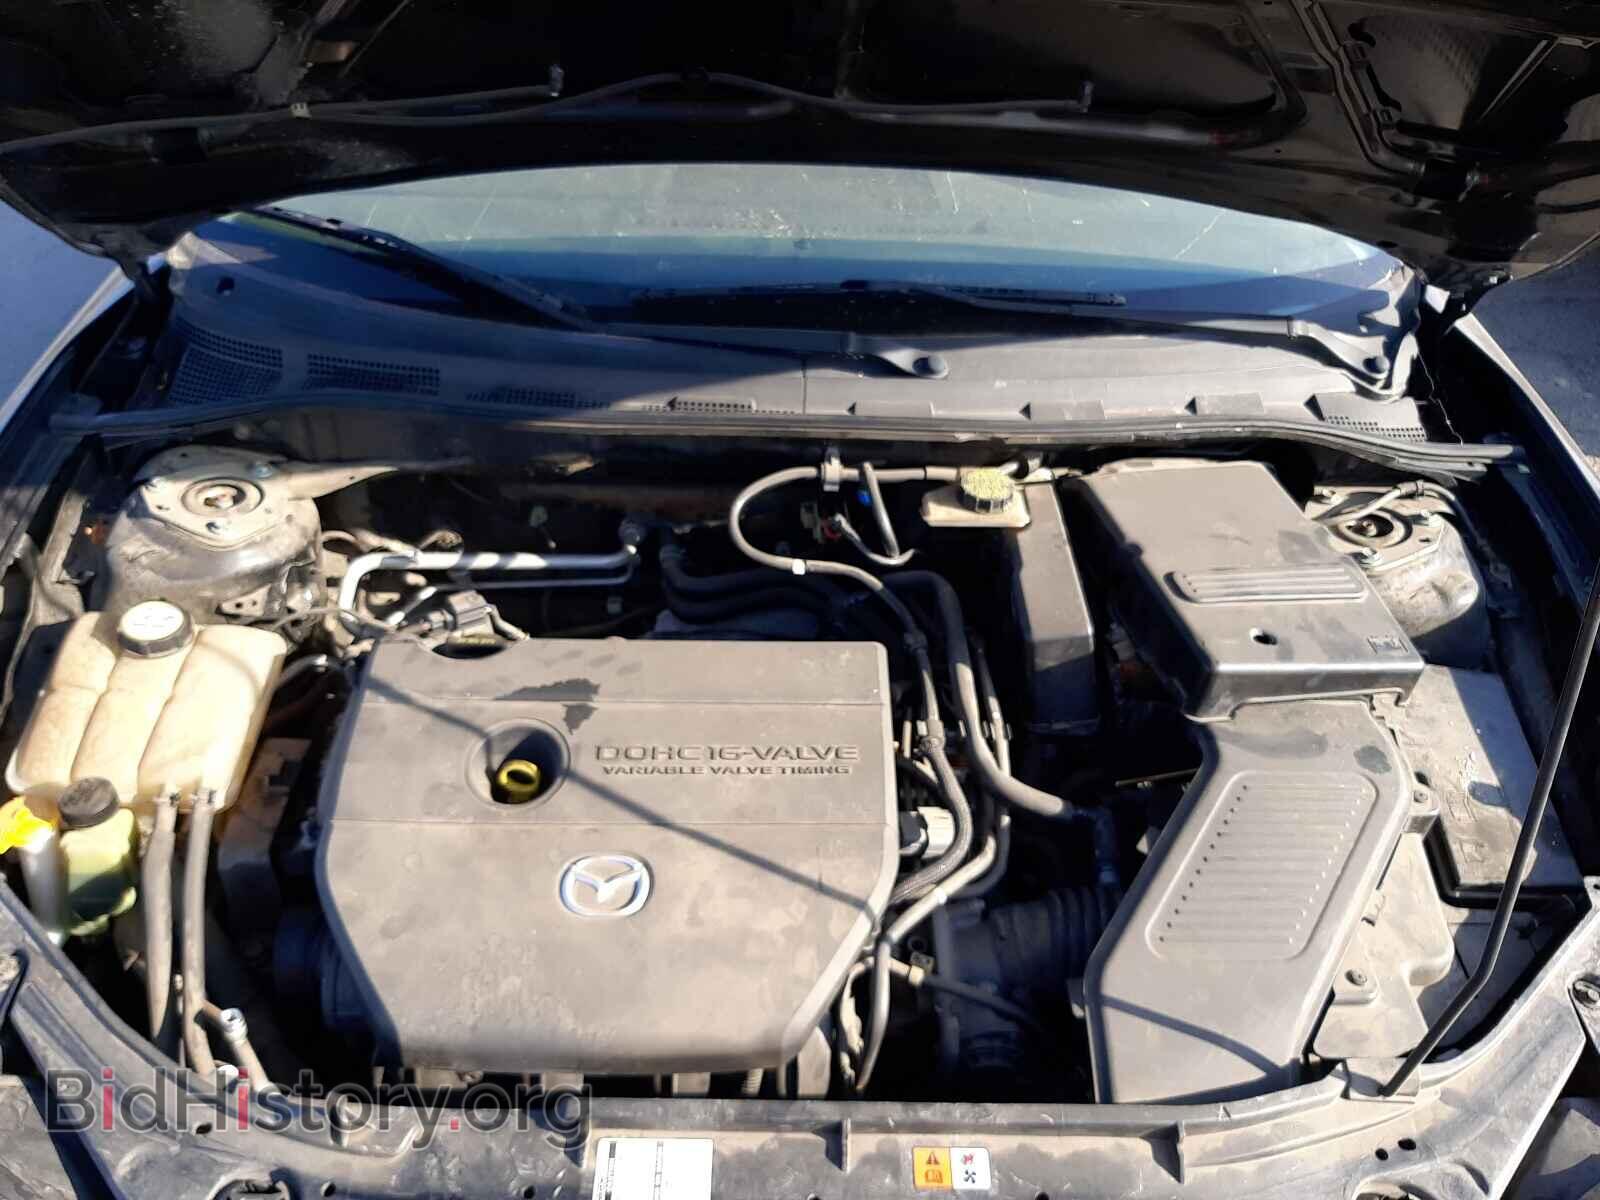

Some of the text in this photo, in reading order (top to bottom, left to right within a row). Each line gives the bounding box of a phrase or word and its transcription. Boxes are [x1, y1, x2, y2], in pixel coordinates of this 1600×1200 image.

[594, 744, 858, 761] DOHC 16-VALVE
[602, 765, 850, 776] VARIABLE VALVE TIMING
